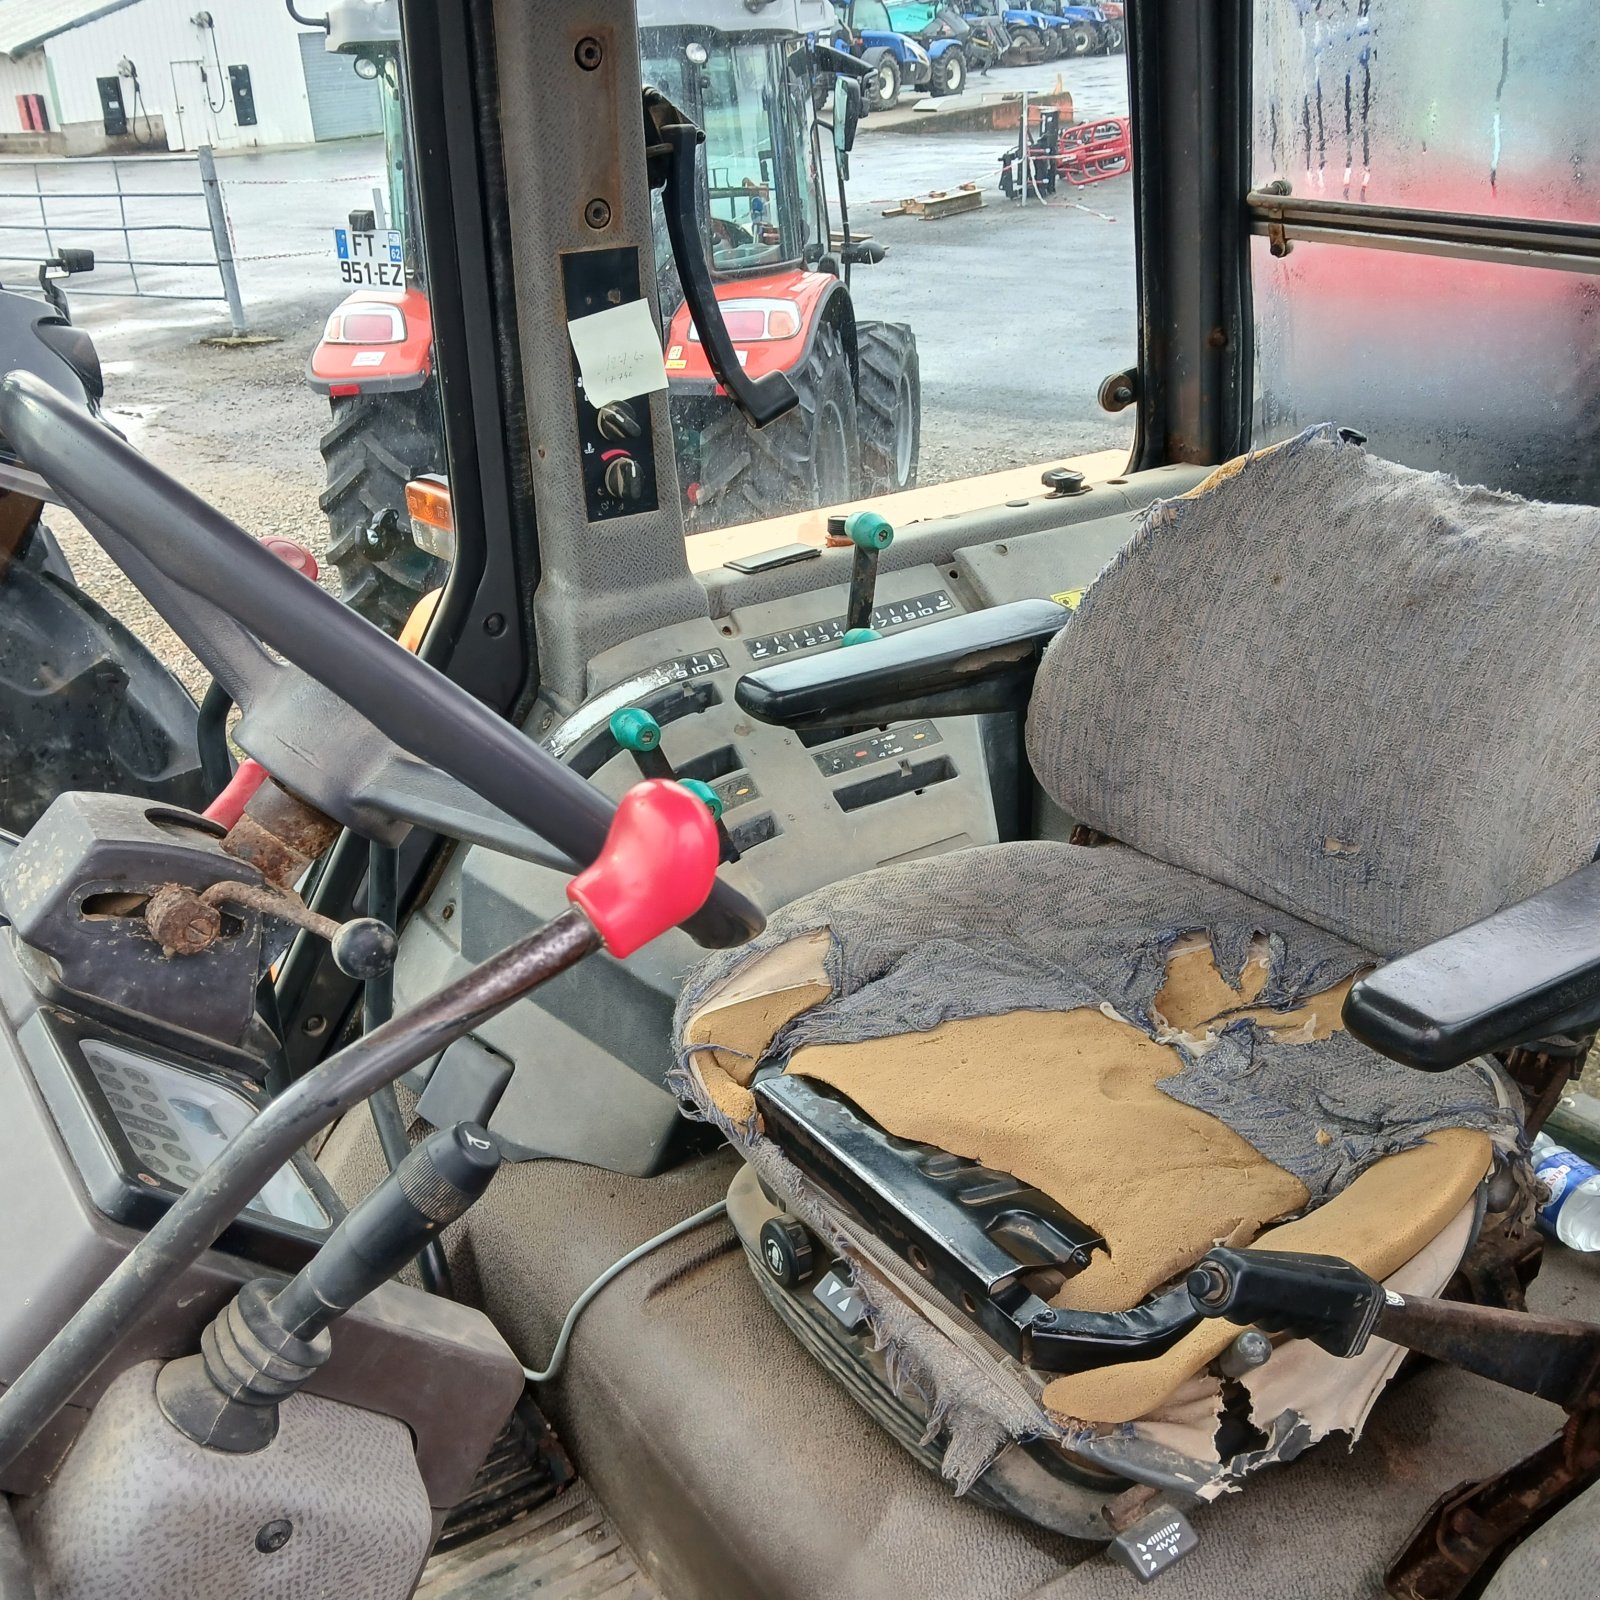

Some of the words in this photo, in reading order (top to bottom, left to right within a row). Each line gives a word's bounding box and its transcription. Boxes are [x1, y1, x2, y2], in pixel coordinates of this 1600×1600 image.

[391, 249, 401, 259] 62
[340, 260, 403, 287] 951-EZ
[776, 646, 788, 654] A
[805, 638, 817, 646] 2
[818, 634, 831, 643] 3
[877, 619, 888, 627] 7
[891, 615, 903, 624] 8
[904, 611, 917, 620] 9
[917, 607, 934, 617] 10
[676, 670, 688, 678] 9
[692, 664, 709, 674] 10
